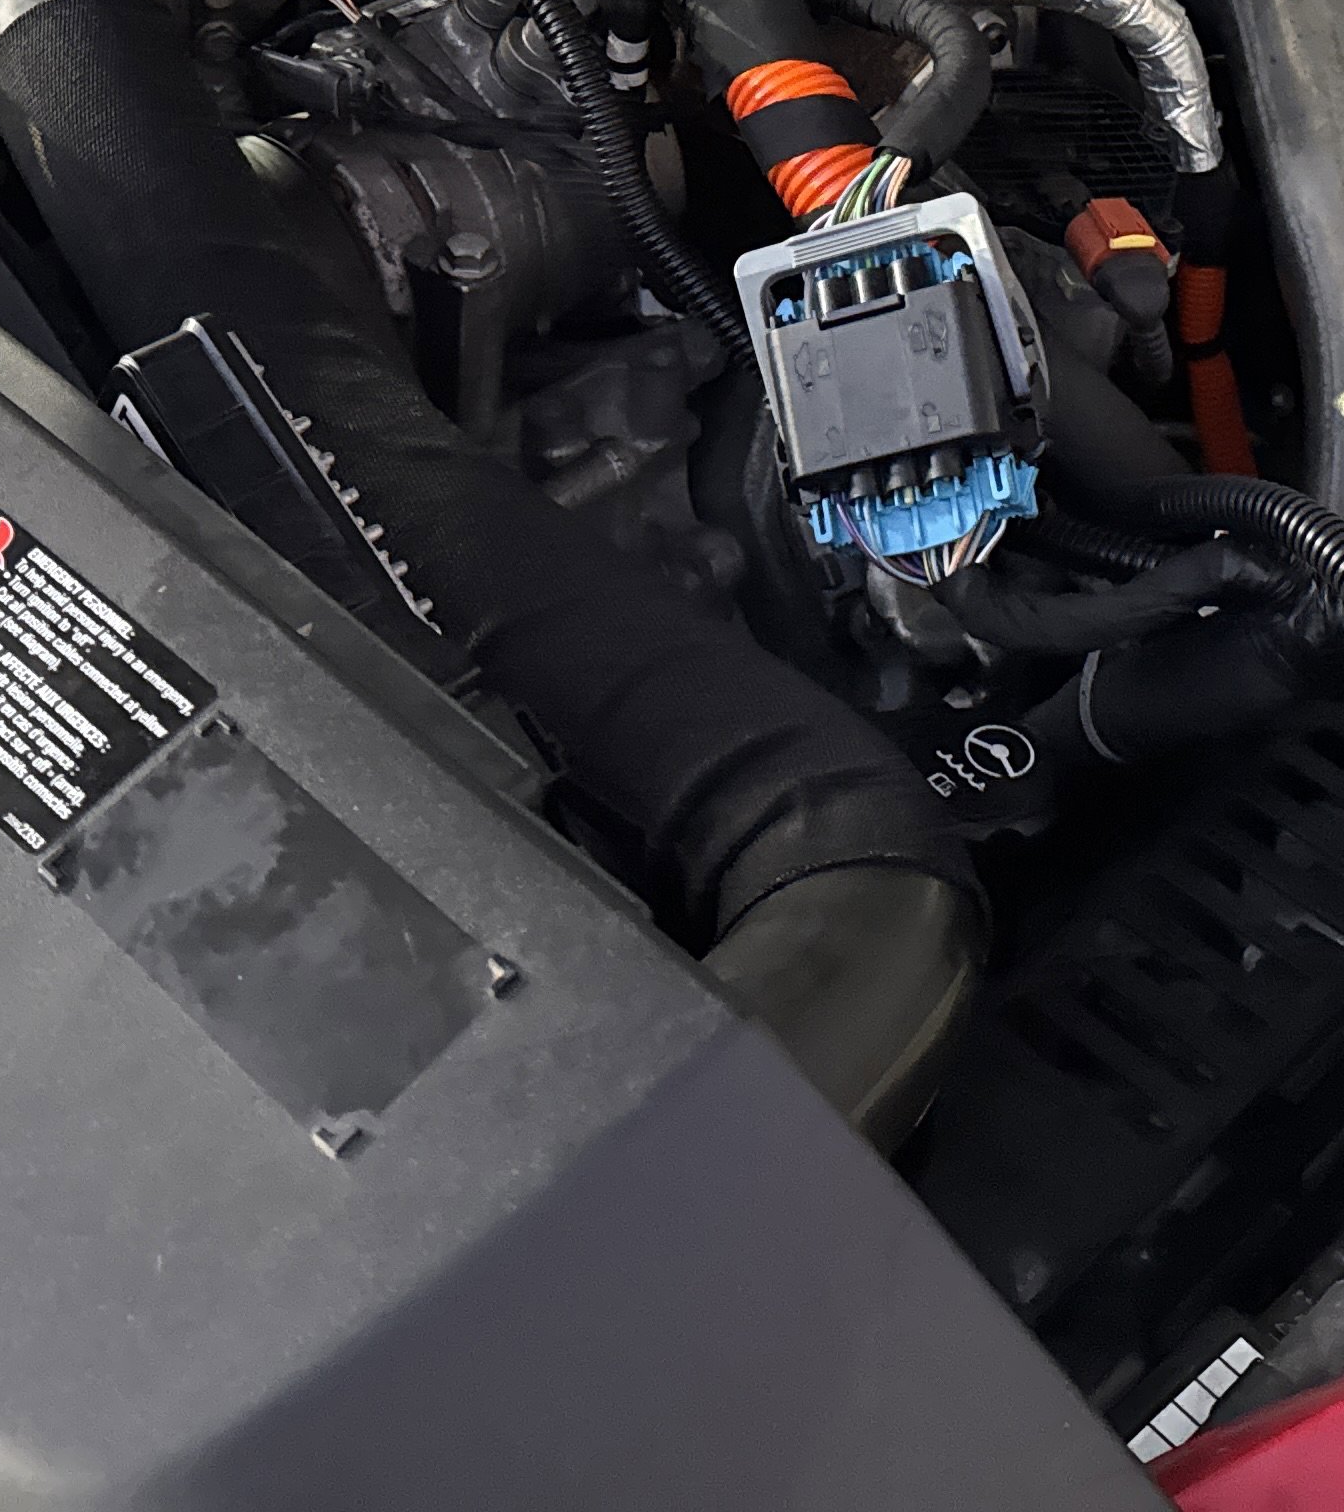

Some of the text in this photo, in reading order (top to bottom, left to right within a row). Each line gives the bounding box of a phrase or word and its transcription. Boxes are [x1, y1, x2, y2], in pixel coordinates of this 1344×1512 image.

[6, 575, 33, 597] Turn
[23, 591, 64, 626] ignition
[55, 617, 74, 632] to
[7, 598, 26, 614] all
[26, 547, 138, 641] EMERGENCY PERSONNEL:
[12, 557, 197, 718] To help avoid personal injury in an emergency,
[16, 608, 59, 644] positive
[15, 630, 65, 673] diagram).
[50, 635, 86, 666] cables
[34, 683, 62, 707] AUX
[77, 659, 131, 704] connected
[10, 713, 33, 733] cas
[122, 697, 141, 713] at
[129, 705, 171, 742] yellow
[27, 704, 90, 759] personnelle,
[8, 736, 31, 756] sur
[30, 754, 53, 774] off
[21, 771, 76, 820] connectés
